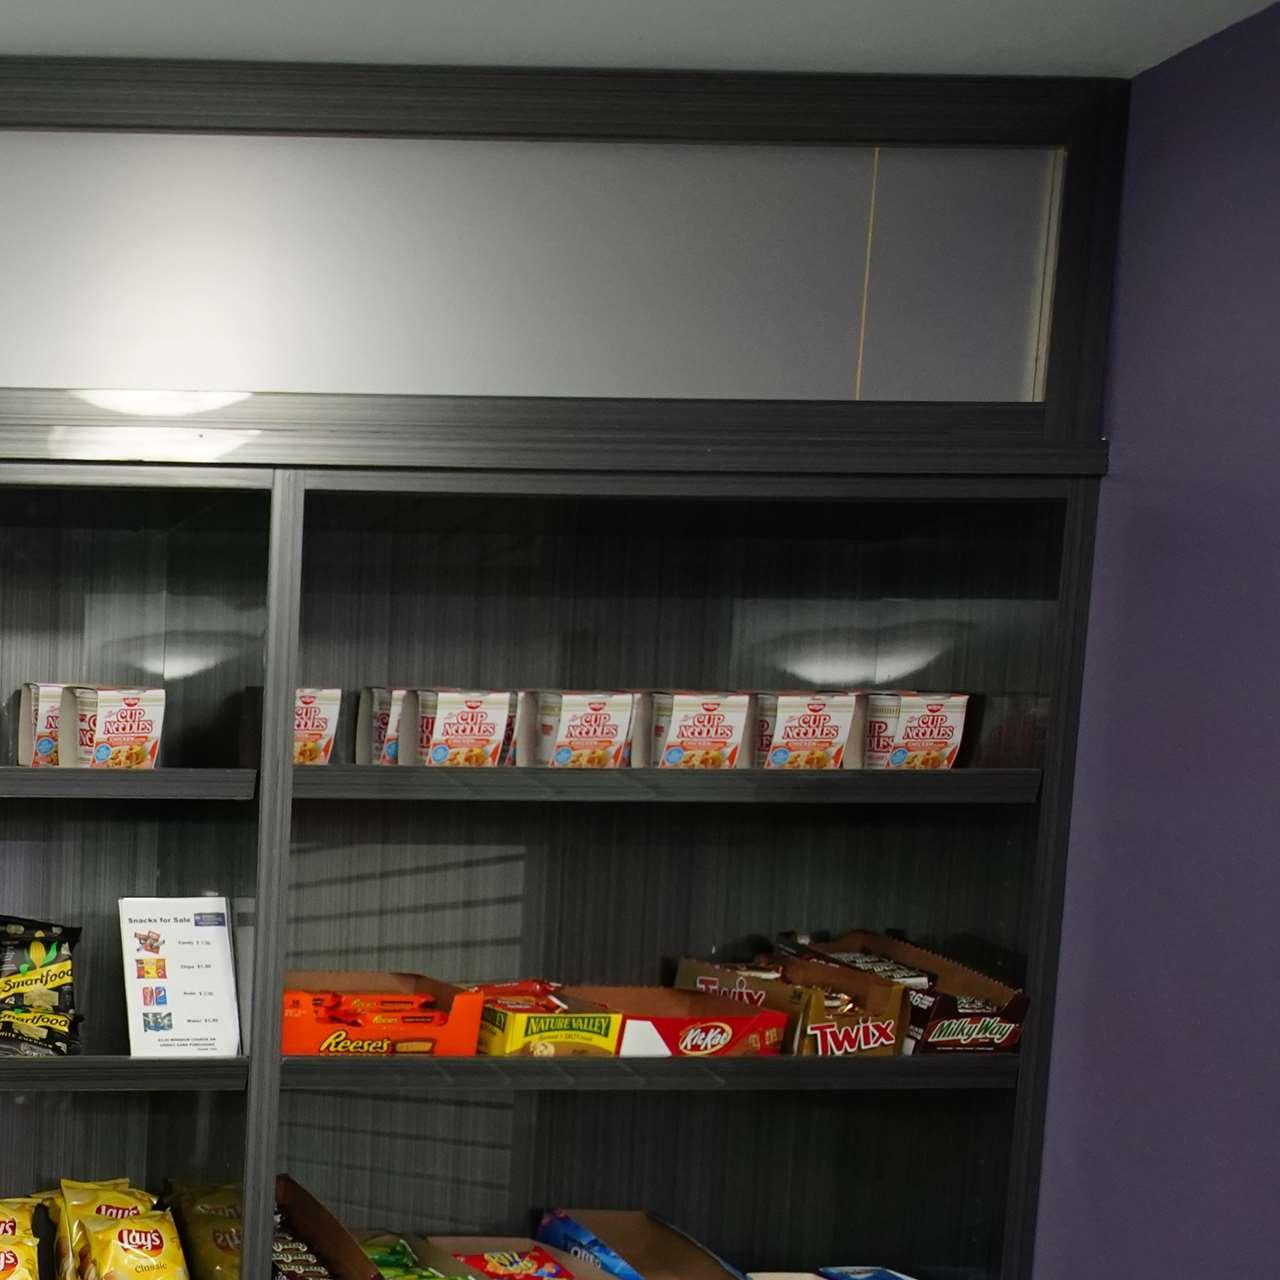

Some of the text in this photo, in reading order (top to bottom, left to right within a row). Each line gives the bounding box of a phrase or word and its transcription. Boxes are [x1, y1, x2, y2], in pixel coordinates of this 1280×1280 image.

[116, 709, 145, 721] CUP
[457, 712, 487, 724] CUP
[581, 713, 610, 725] CUP
[693, 713, 724, 726] CUP
[798, 714, 831, 727] CUP
[918, 715, 947, 727] CUP
[103, 720, 152, 734] NOODLES
[442, 723, 495, 736] NOODLES
[566, 725, 618, 738] NOODLES
[677, 725, 733, 739] NOODLES
[783, 725, 839, 739] NOODLES
[903, 726, 954, 739] NOODLES
[527, 1016, 609, 1037] NATURE VALLEY
[320, 1030, 392, 1053] Reese's
[808, 1015, 895, 1057] Twix
[122, 1229, 161, 1251] Lay's
[134, 1262, 168, 1273] Classic
